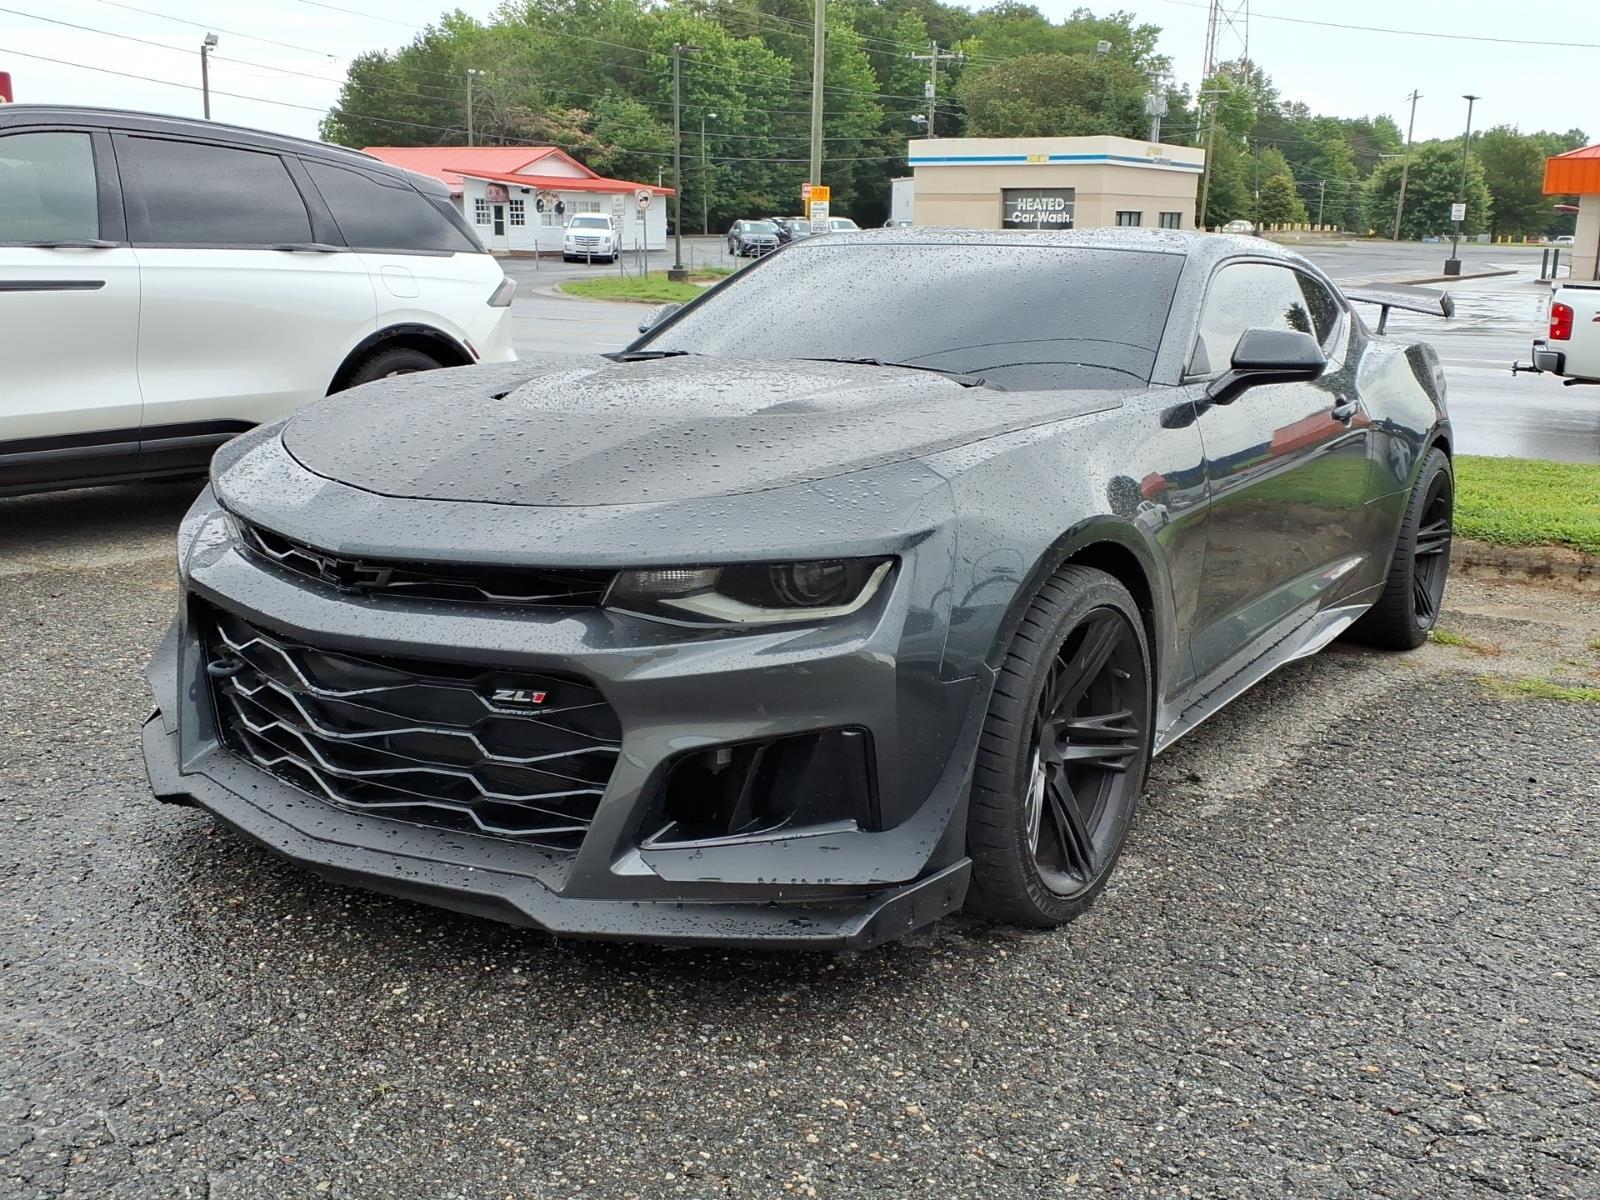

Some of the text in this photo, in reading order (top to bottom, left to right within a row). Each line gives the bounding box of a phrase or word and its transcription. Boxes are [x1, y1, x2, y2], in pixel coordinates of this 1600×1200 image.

[1017, 198, 1065, 210] HEATED
[1012, 211, 1070, 223] Car Wash
[492, 689, 546, 703] ZL1
